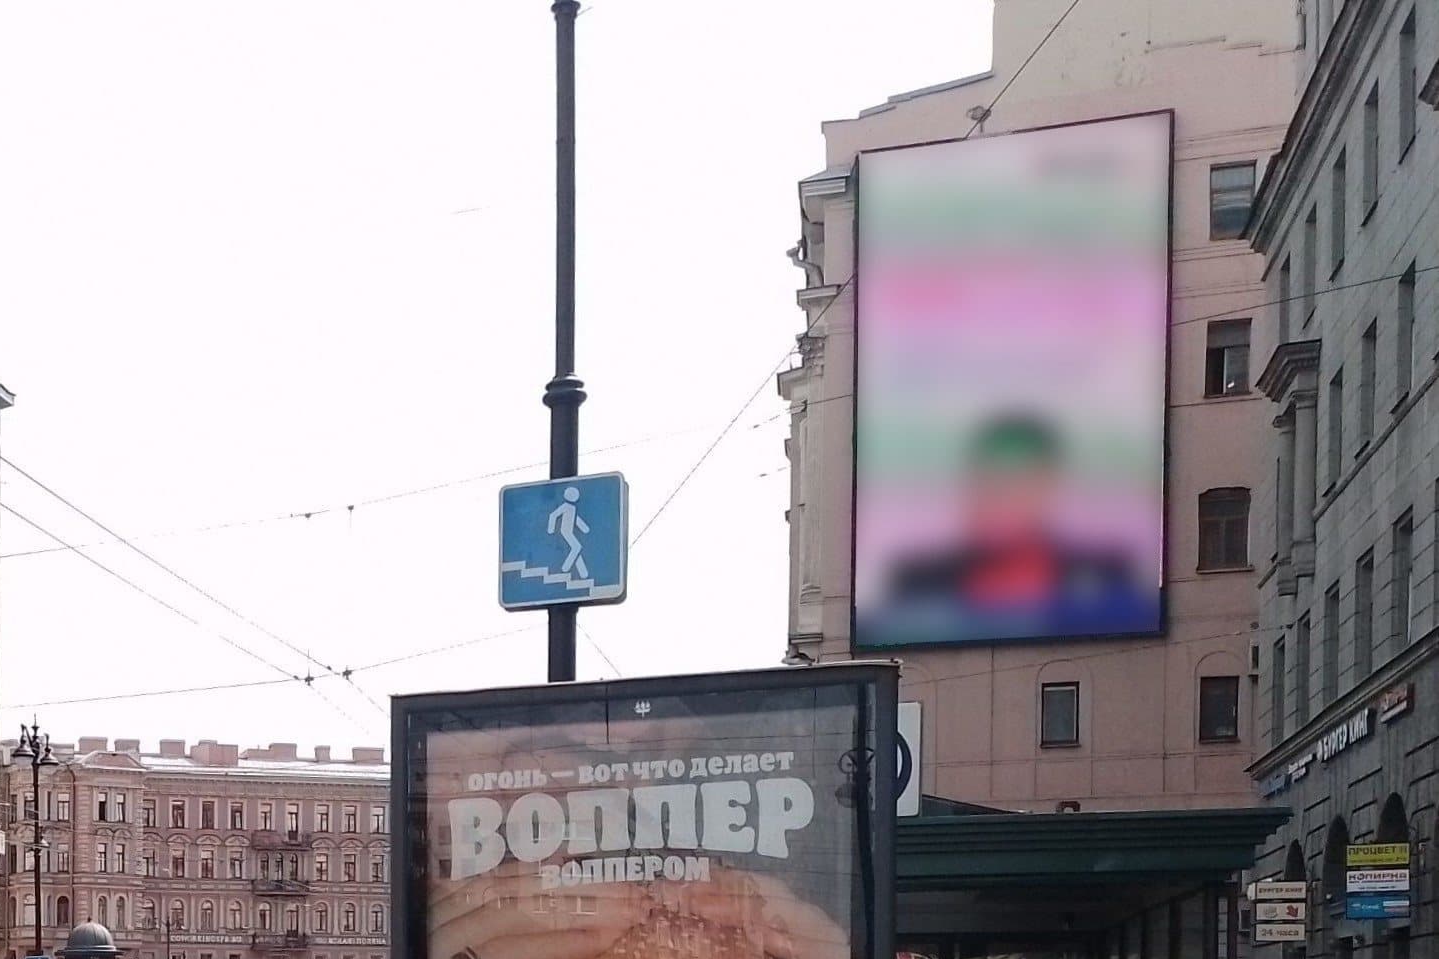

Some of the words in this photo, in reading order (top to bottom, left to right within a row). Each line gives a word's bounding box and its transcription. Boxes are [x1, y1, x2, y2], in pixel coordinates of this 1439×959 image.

[468, 768, 547, 791] огонь
[578, 762, 629, 785] вот
[632, 760, 685, 781] что
[690, 752, 794, 779] делает
[449, 777, 816, 881] ВОППЕР
[540, 856, 711, 890] ВОППЕРОМ
